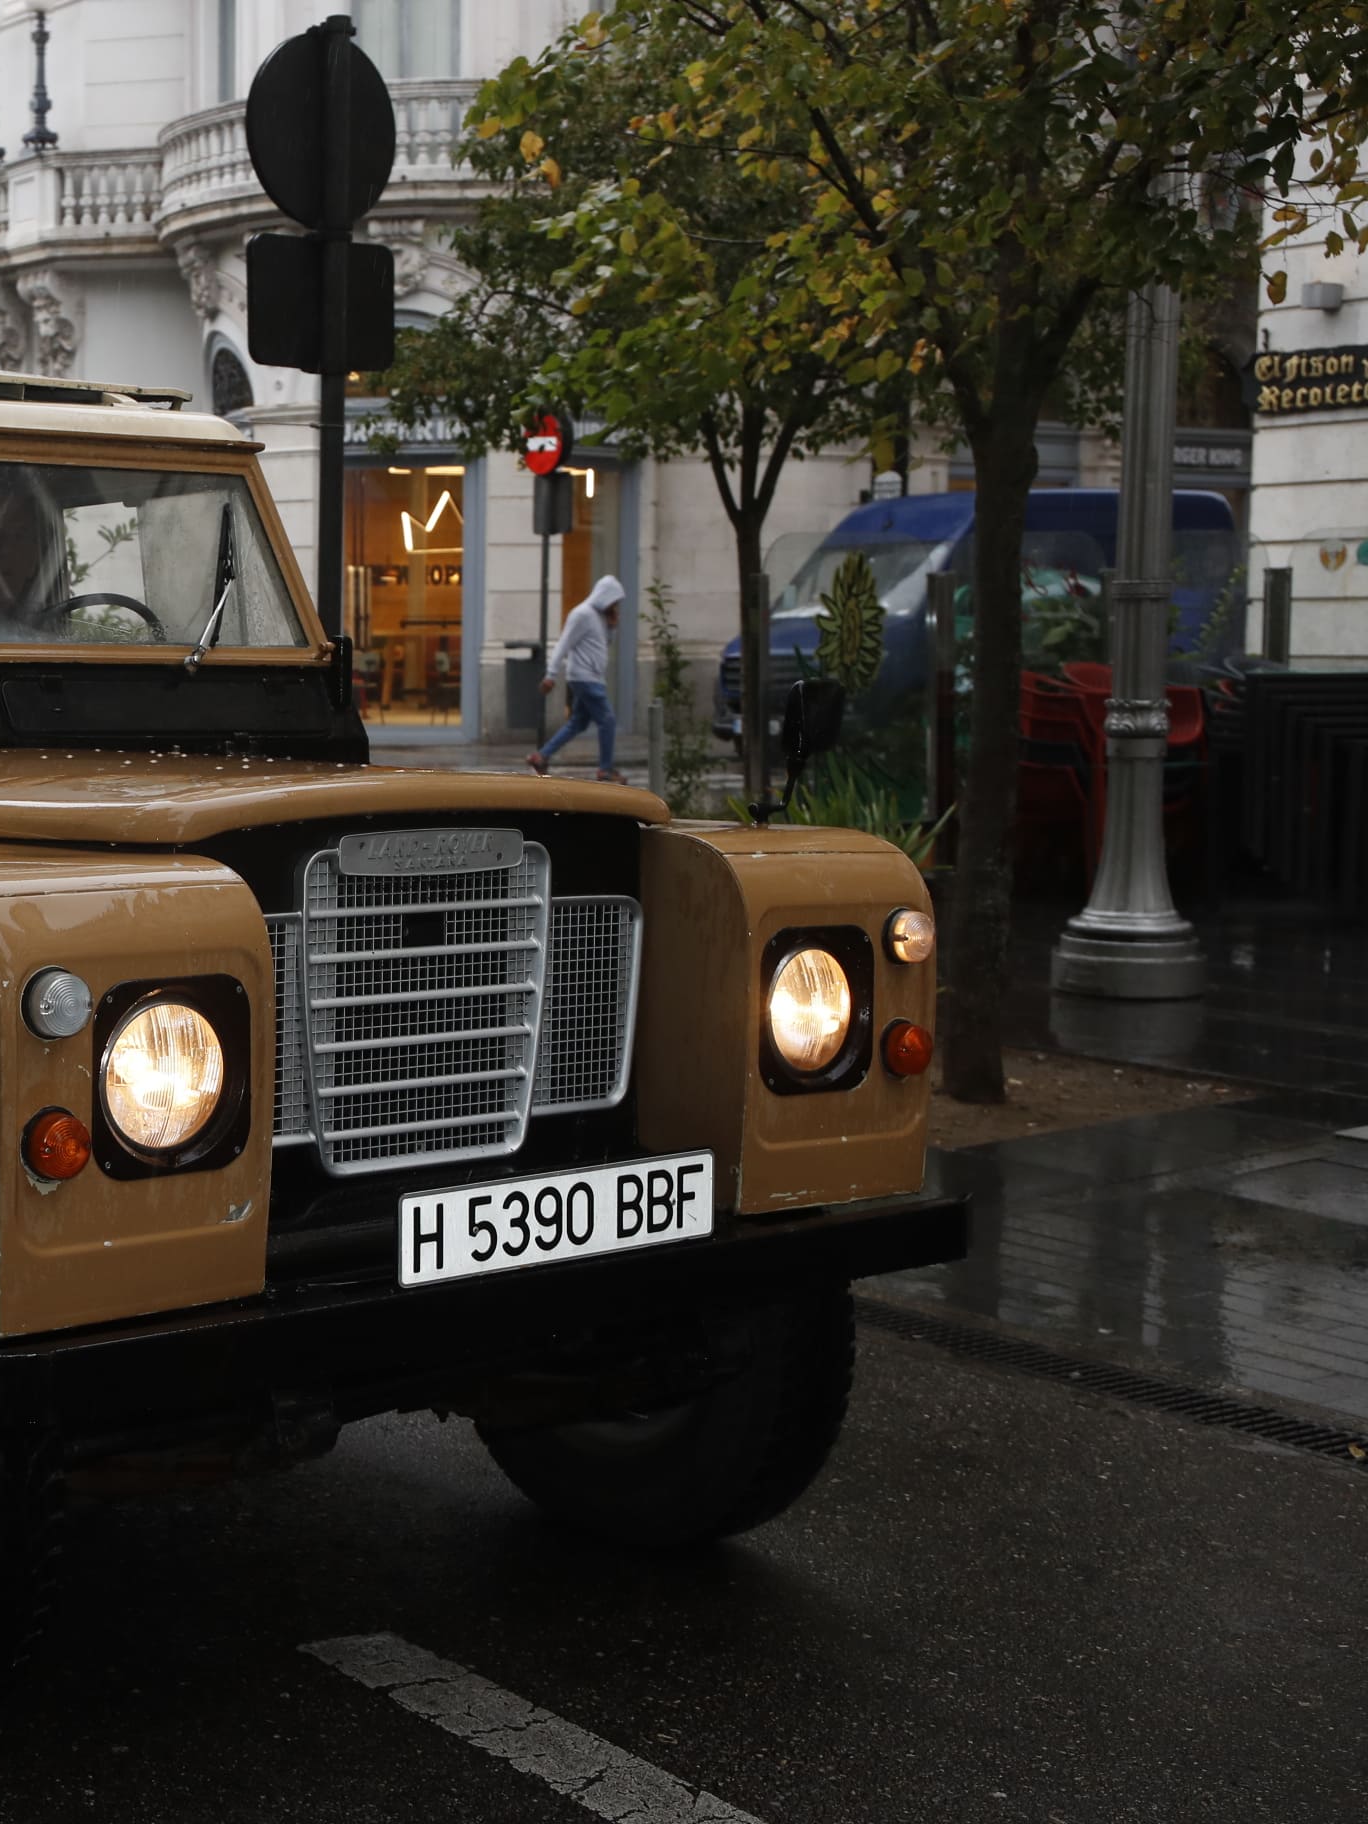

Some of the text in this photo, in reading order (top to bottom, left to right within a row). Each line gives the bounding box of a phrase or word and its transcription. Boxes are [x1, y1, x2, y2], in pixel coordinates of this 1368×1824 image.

[1173, 446, 1207, 465] RGER
[367, 831, 494, 861] LAND-ROVER
[394, 855, 467, 871] SANTANA
[412, 1163, 704, 1274] H 5390 BBF
